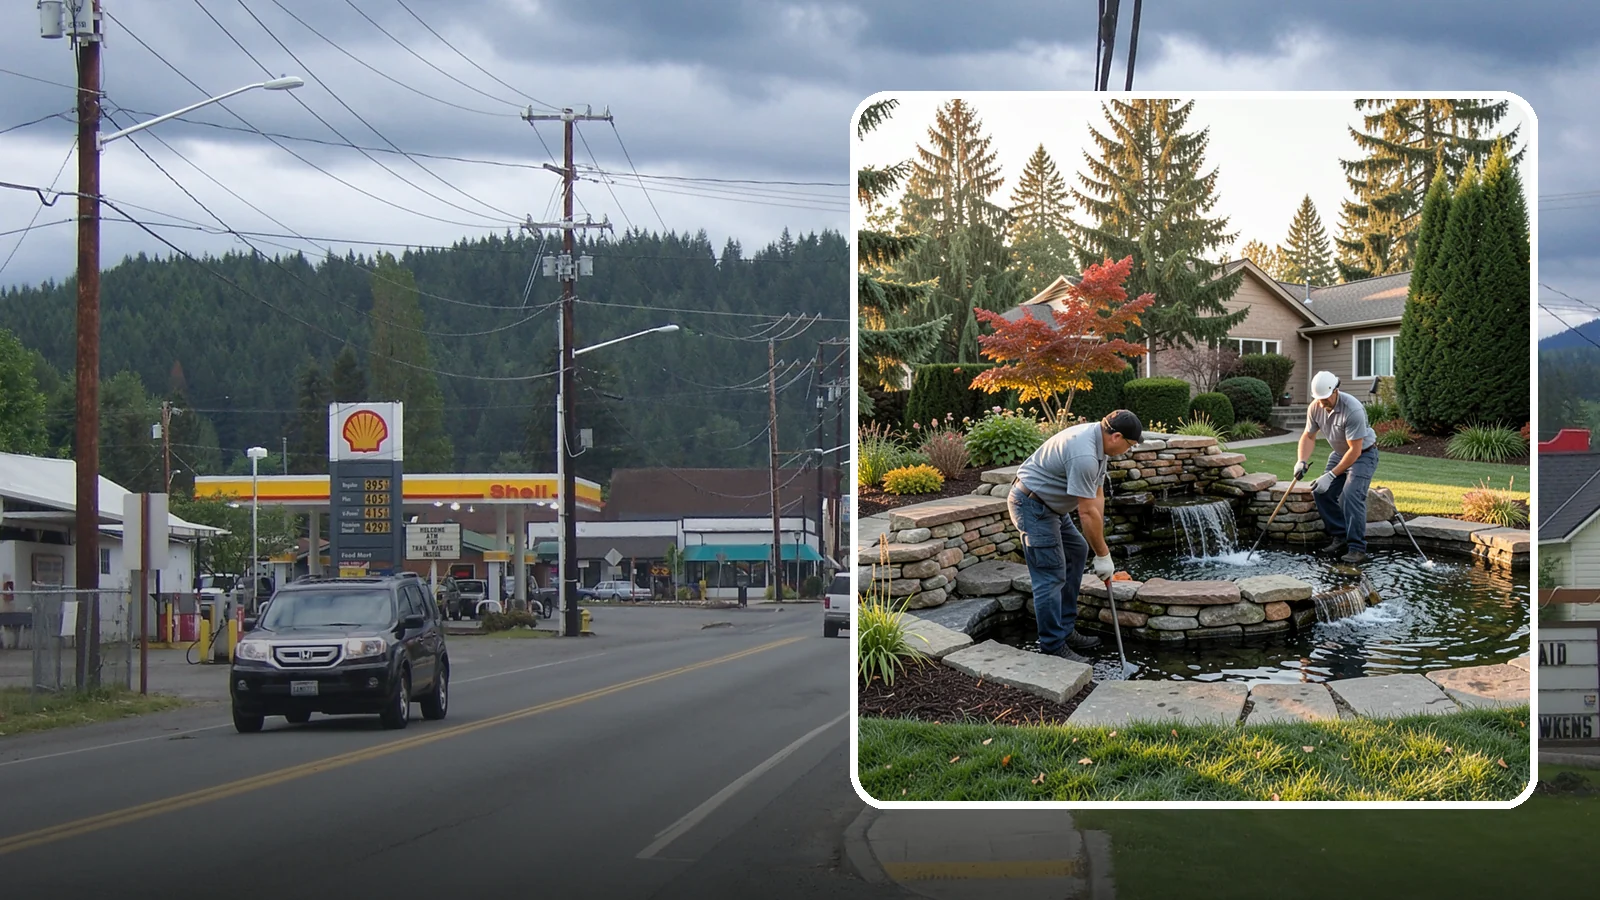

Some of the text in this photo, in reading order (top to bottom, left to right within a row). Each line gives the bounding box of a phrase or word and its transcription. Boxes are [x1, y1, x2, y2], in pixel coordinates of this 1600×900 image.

[490, 484, 548, 499] Shell
[1538, 643, 1567, 666] AID
[1538, 716, 1592, 739] WKENS
